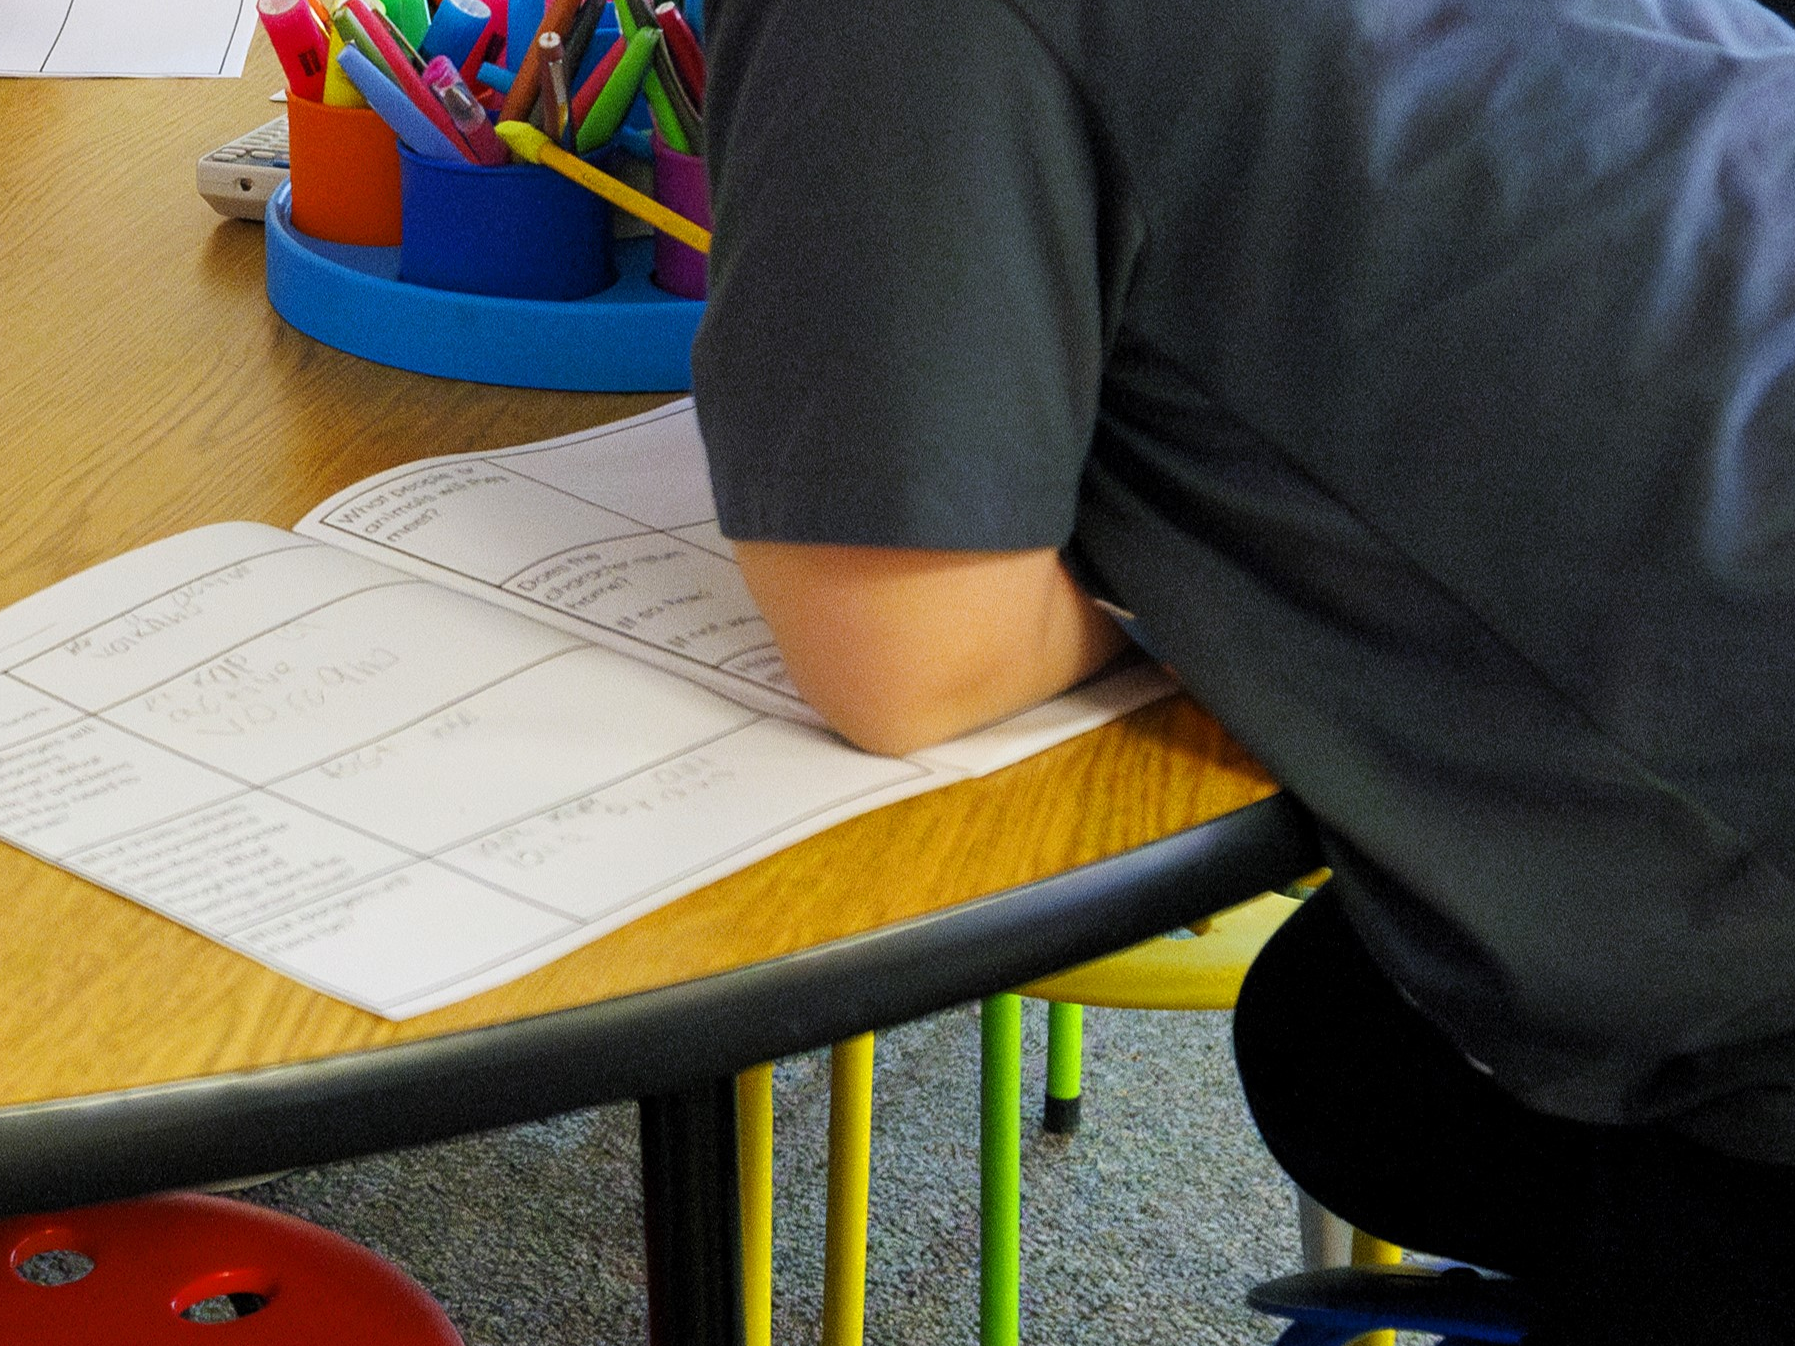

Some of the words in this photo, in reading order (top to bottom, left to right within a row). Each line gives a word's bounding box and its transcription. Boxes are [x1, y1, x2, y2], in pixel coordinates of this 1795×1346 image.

[338, 494, 390, 524] What
[392, 471, 454, 500] people
[365, 493, 437, 535] animals
[386, 507, 440, 543] meet?
[517, 564, 572, 592] Does
